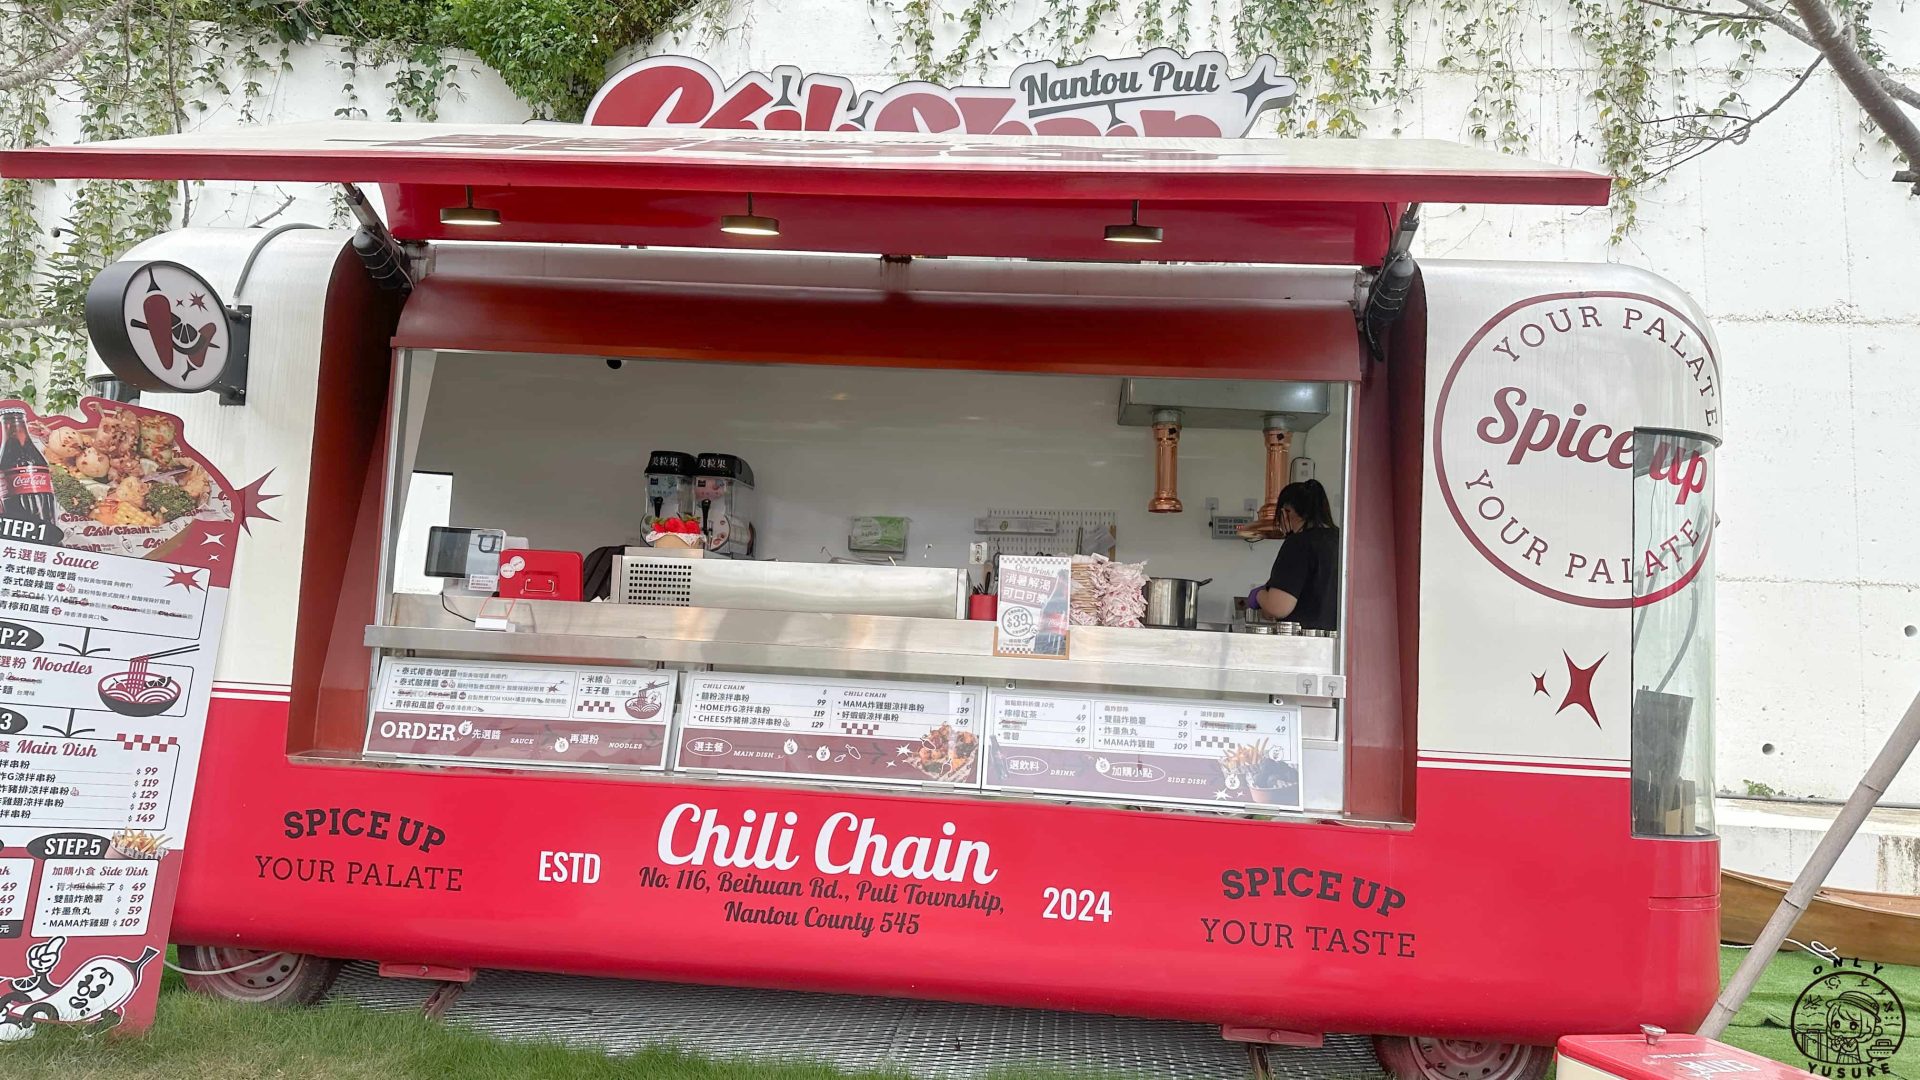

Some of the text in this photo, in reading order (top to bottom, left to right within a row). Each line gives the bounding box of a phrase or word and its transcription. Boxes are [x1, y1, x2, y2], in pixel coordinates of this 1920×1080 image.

[1020, 61, 1220, 105] Nantou Puli
[1493, 306, 1718, 427] YOUR PALATE
[1477, 387, 1708, 505] Spice up
[0, 517, 46, 541] TEP.1
[1465, 469, 1700, 584] YOUR PALATE
[2, 546, 100, 570] 先選醬 Sauce
[2, 576, 54, 590] 泰式酸辣醬
[1004, 572, 1051, 591] 消暑解渴
[1007, 613, 1028, 628] $39
[0, 627, 28, 647] P.2
[33, 656, 94, 675] Noodles
[585, 686, 609, 695] 王子麵
[380, 720, 456, 741] ORDER
[471, 728, 501, 740] 先選醬
[569, 734, 599, 745] 再選粉
[16, 740, 58, 756] Main
[62, 742, 98, 758] Dish
[694, 741, 724, 753] 選主餐
[144, 766, 158, 776] 99
[1112, 766, 1153, 778] 加購小點
[142, 778, 159, 788] 119
[0, 796, 64, 808] 雞翅涼拌串粉
[137, 802, 157, 811] 139
[140, 790, 159, 799] 129
[135, 813, 155, 823] 149
[283, 807, 446, 853] SPICE UP
[44, 838, 102, 856] STEP.5
[657, 803, 998, 885] Chili Chain
[52, 866, 149, 876] 加購小食 Side Dish
[255, 855, 463, 892] YOUR PALATE
[538, 850, 601, 884] ESTD
[1, 882, 17, 891] 49
[131, 882, 146, 891] 49
[639, 866, 1004, 916] No. 116, Beihuan Rd., Puli Township,
[1221, 866, 1406, 917] SPICE UP
[0, 895, 15, 904] 49
[129, 894, 144, 903] 59
[1042, 886, 1112, 923] 2024
[51, 906, 92, 916] 炸墨魚丸
[127, 906, 142, 915] 59
[724, 901, 920, 938] Nantou County 545
[49, 918, 109, 928] MAMA炸雞翅
[119, 918, 140, 927] 109
[1200, 918, 1416, 958] YOUR TASTE
